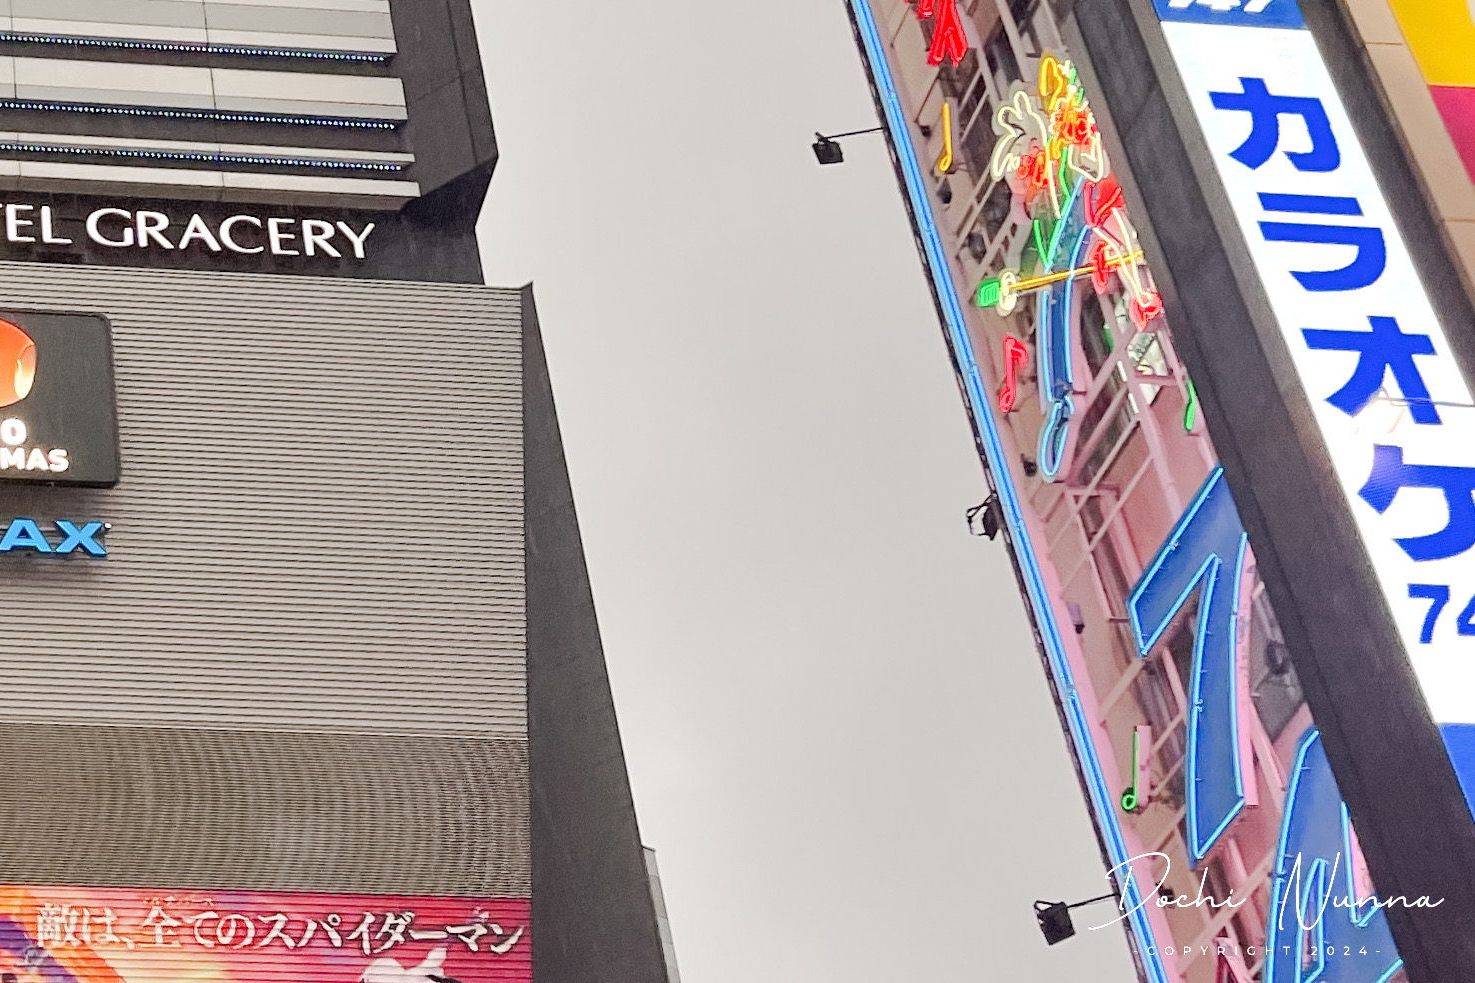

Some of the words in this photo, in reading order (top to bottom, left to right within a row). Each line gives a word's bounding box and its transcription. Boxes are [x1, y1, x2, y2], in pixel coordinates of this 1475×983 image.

[86, 207, 375, 259] GRACERY
[1209, 76, 1475, 563] カラオケ
[36, 902, 524, 956] 敵は、全てのスパイダーマン
